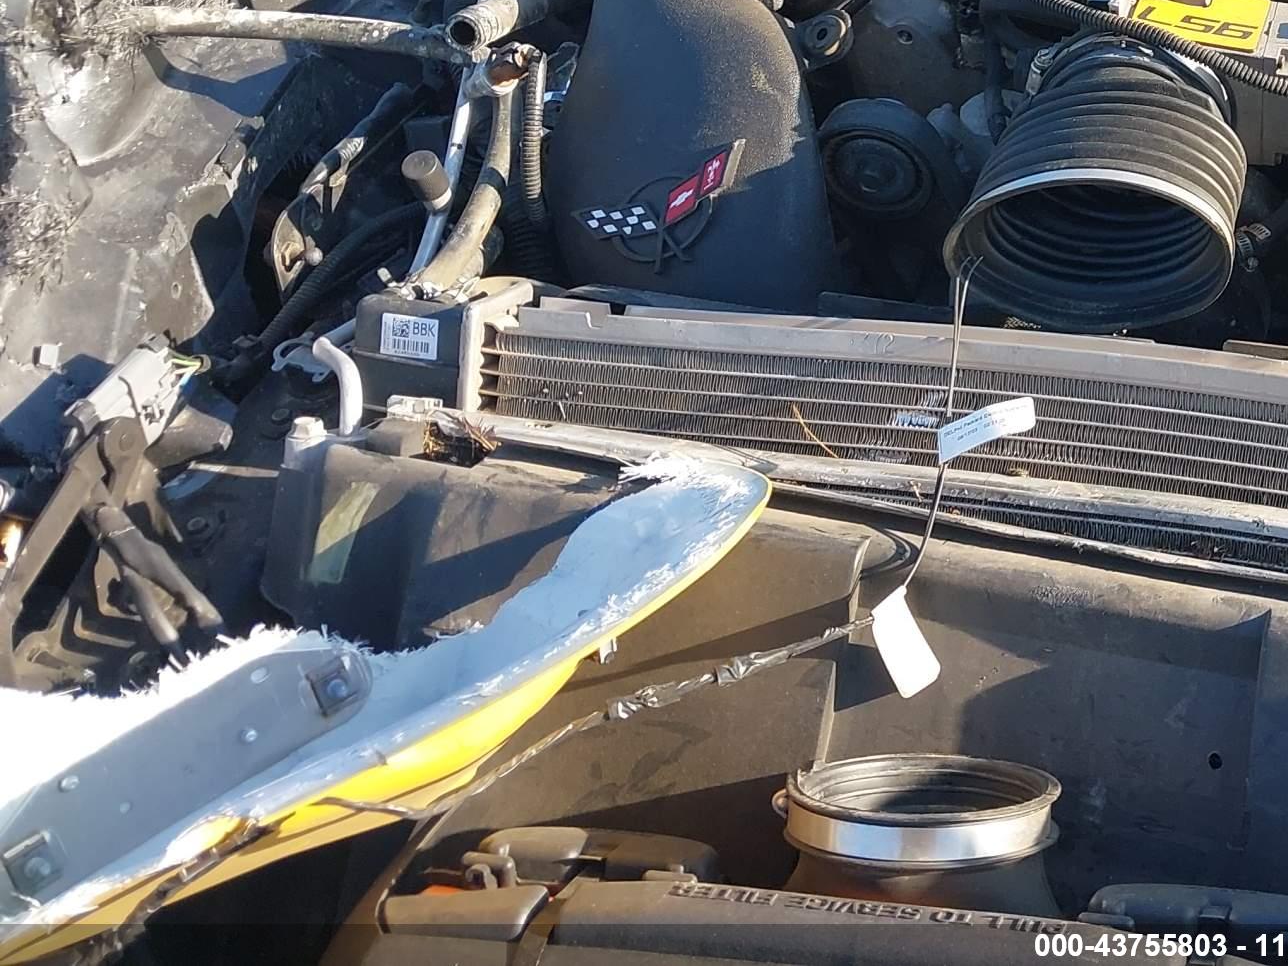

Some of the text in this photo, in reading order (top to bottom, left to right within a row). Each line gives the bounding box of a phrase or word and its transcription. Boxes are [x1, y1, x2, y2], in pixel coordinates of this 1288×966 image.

[1137, 5, 1258, 40] LS6
[413, 322, 435, 337] BBK
[668, 880, 1066, 934] PULL TO SERVICE FILTER
